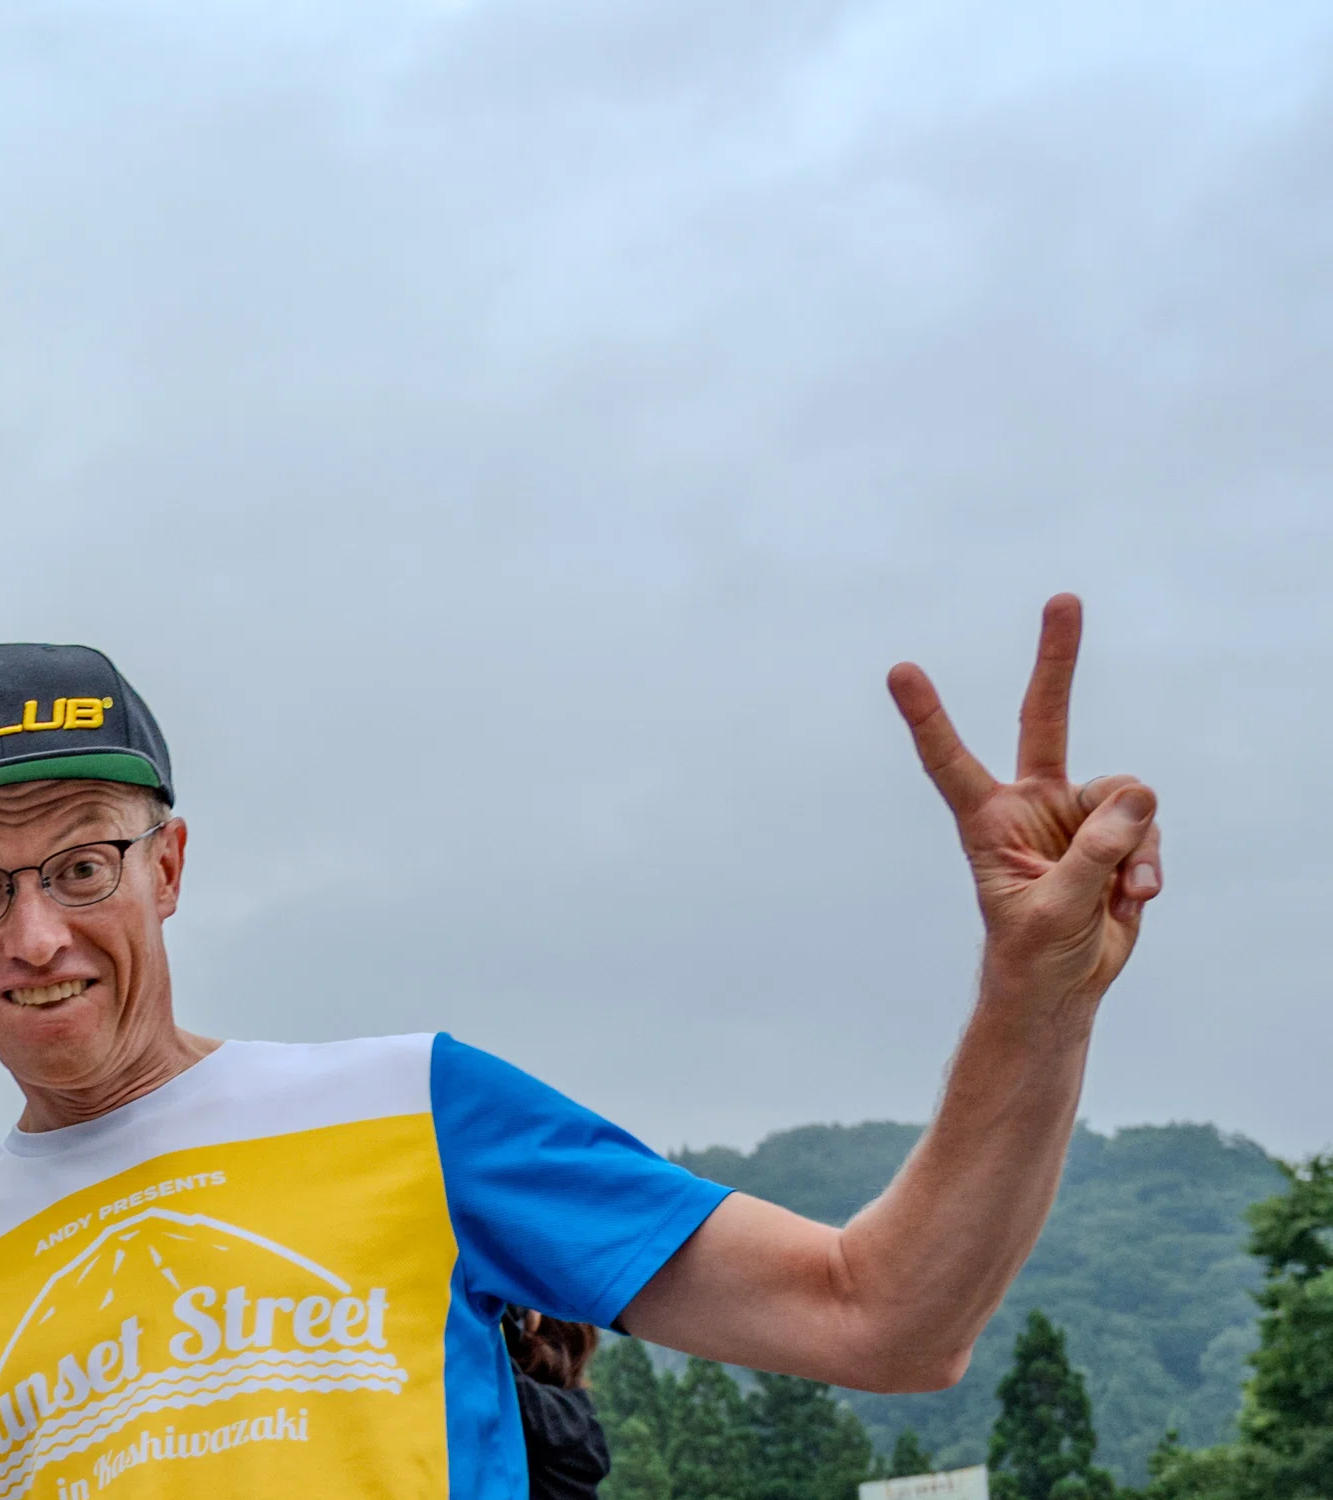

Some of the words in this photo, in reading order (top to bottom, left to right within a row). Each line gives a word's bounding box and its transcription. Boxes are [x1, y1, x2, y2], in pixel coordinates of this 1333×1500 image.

[34, 1213, 90, 1257] ANDY
[98, 1170, 227, 1221] PRESENTS
[169, 1285, 390, 1363] Street
[93, 1408, 309, 1490] Kashiwazaki
